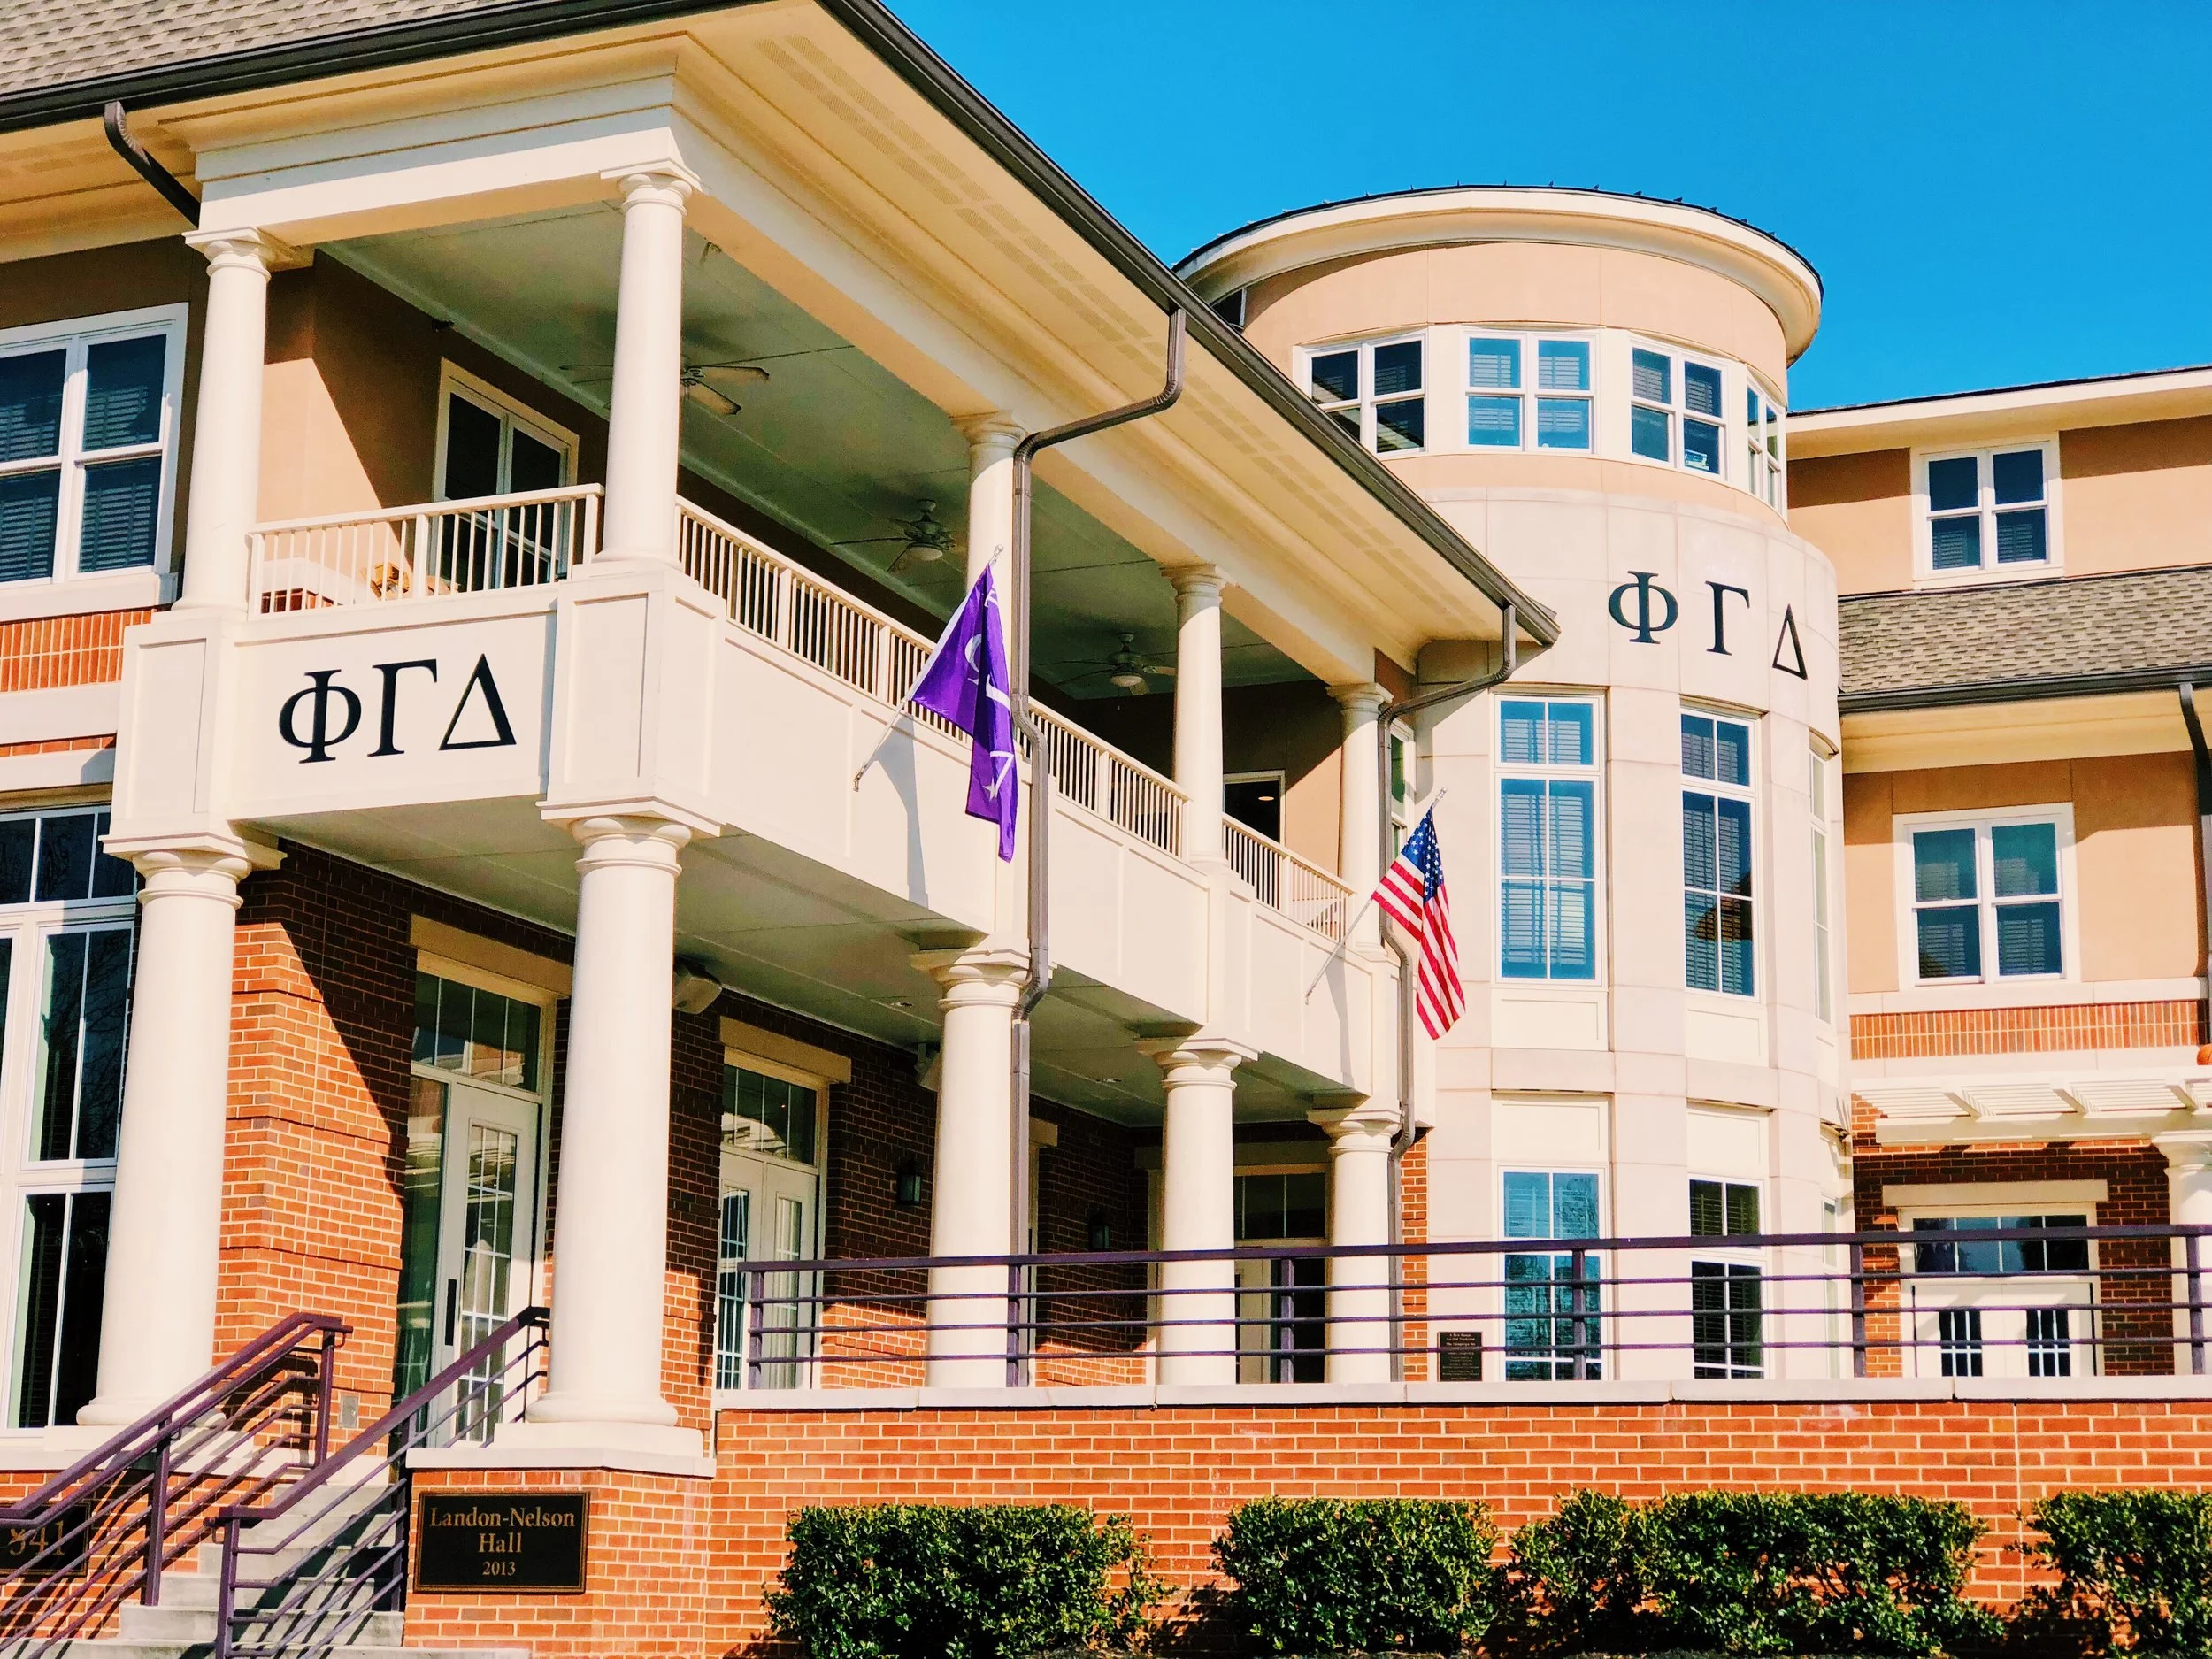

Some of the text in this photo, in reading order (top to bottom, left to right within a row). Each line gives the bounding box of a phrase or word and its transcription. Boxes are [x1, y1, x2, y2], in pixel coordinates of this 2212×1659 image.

[429, 1506, 575, 1528] Landon-Nelson
[478, 1532, 523, 1554] Hall
[482, 1561, 517, 1577] 2013
